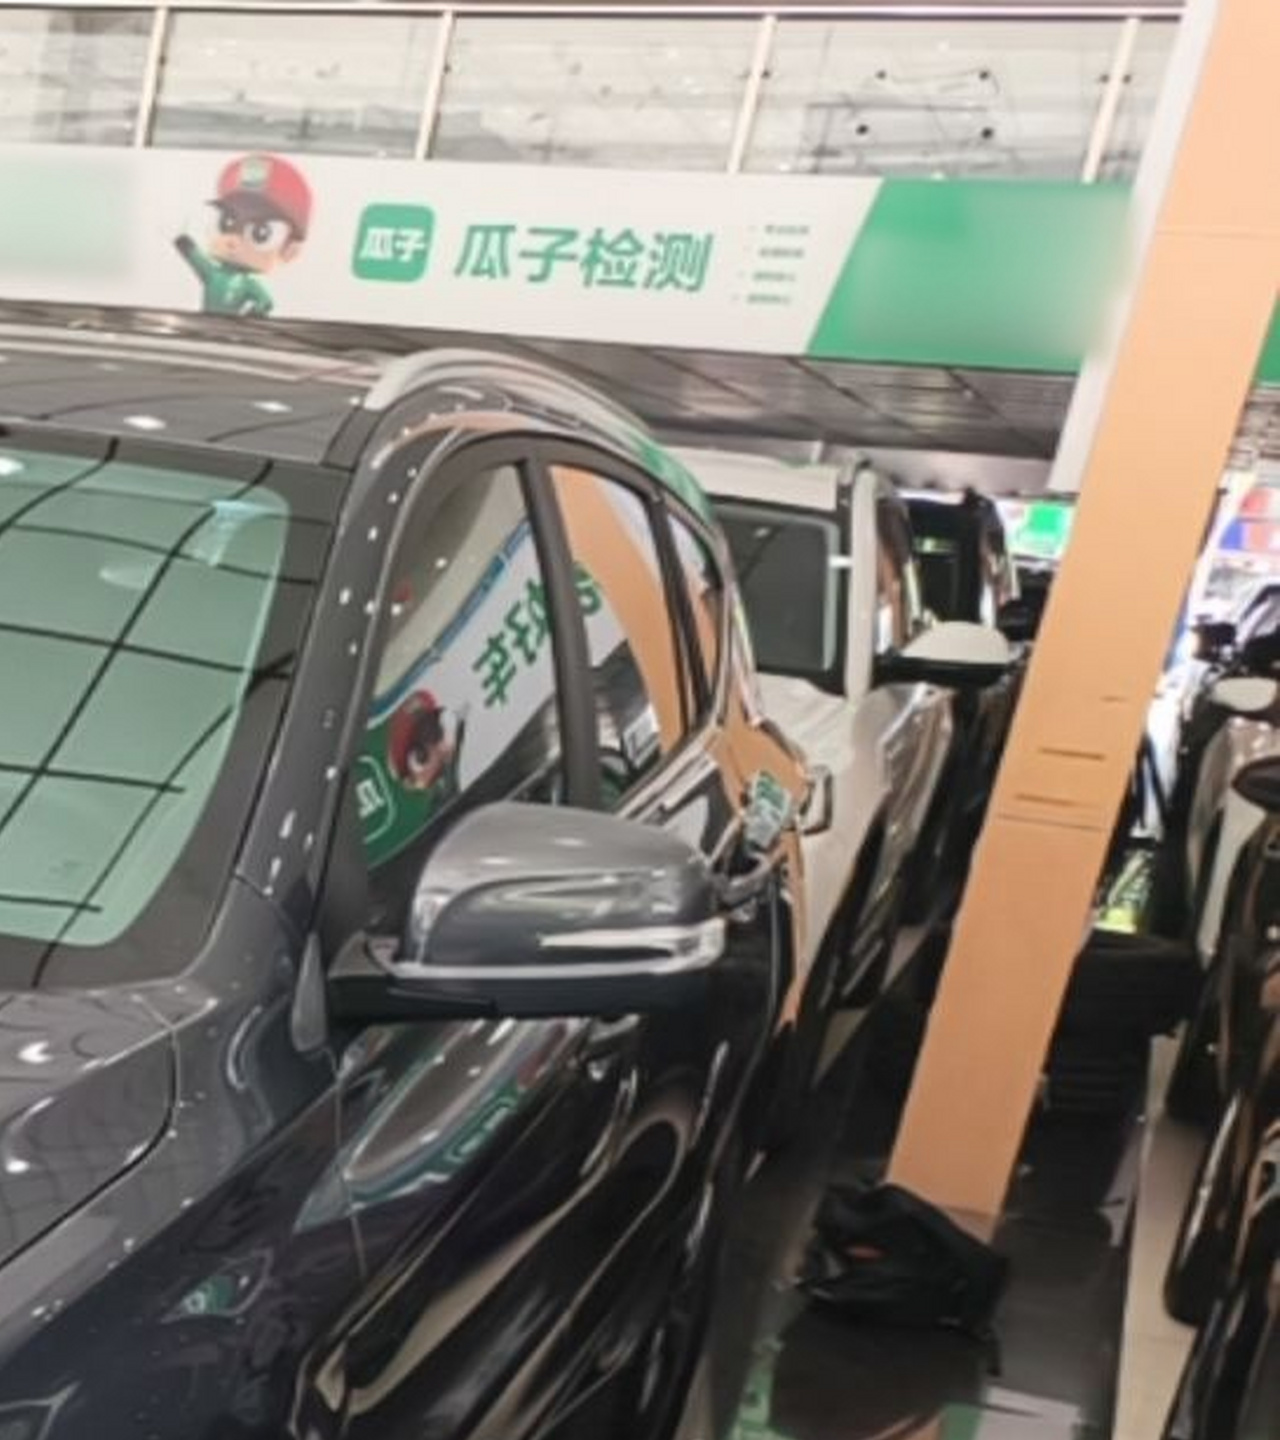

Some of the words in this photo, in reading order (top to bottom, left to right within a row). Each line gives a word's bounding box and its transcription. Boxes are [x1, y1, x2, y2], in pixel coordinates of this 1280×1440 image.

[358, 226, 427, 263] 瓜子
[453, 224, 715, 293] 瓜子检测
